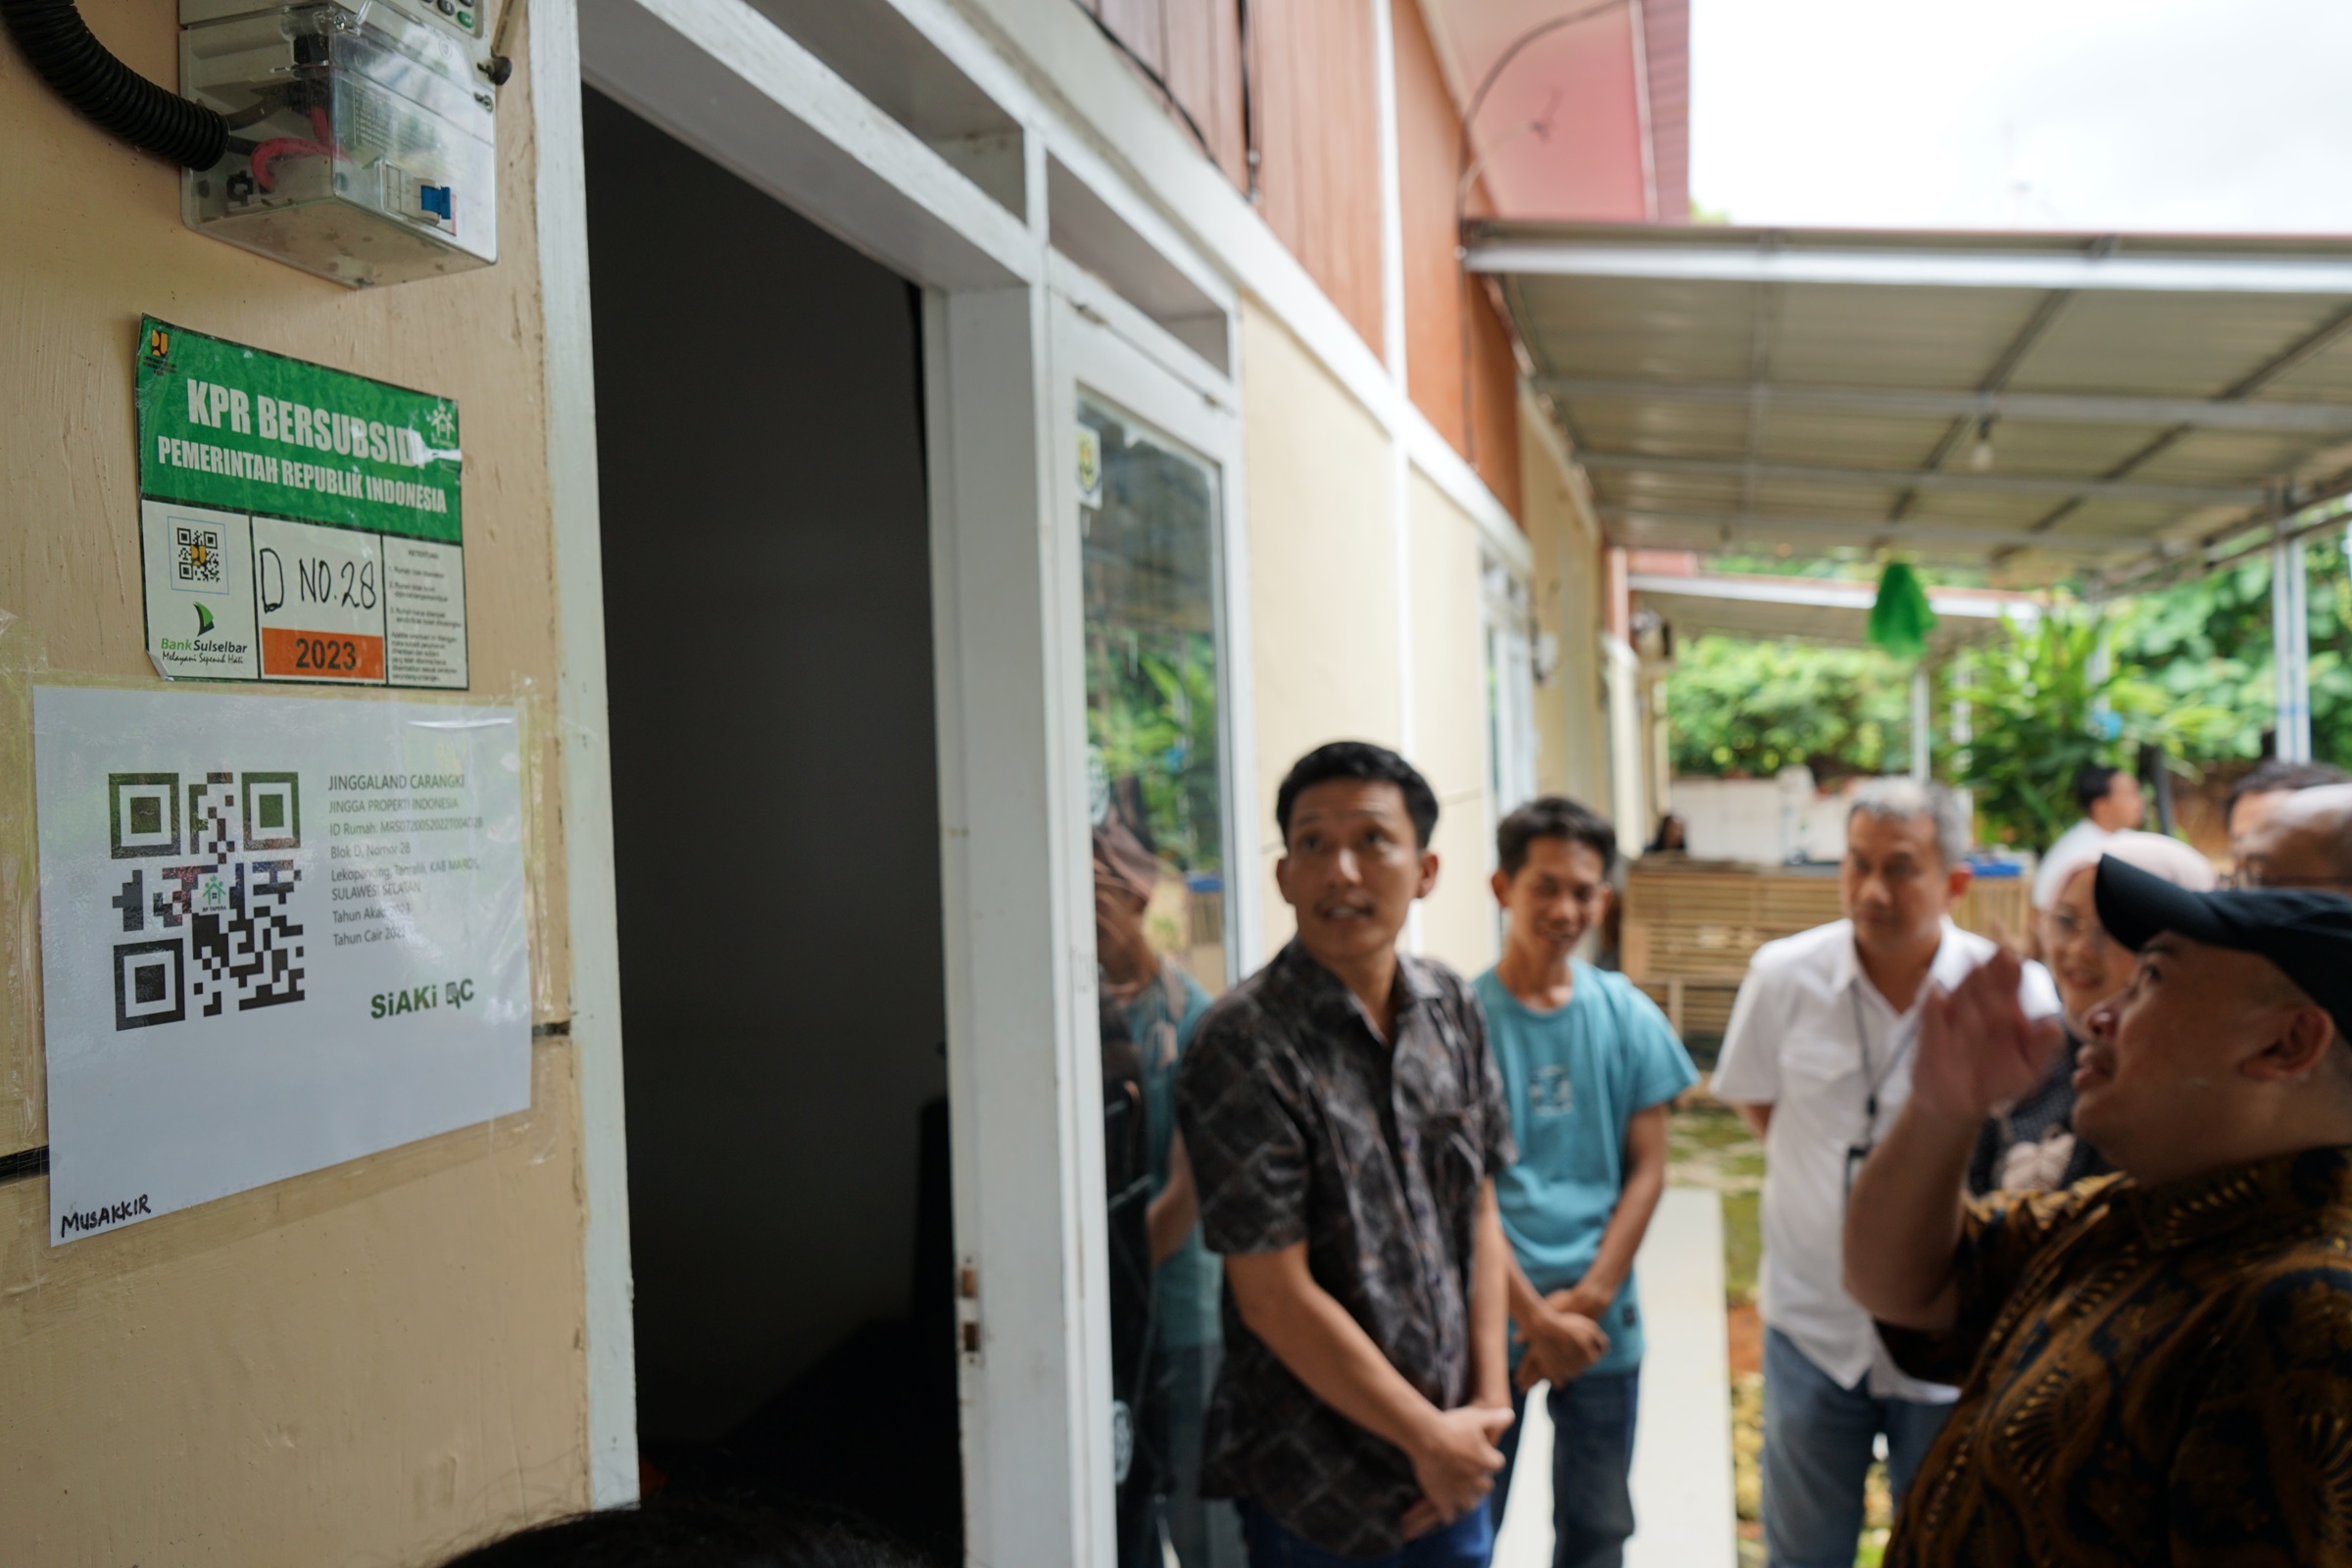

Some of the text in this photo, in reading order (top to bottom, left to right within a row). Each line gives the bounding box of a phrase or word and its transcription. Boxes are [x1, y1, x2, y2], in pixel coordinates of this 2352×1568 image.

[187, 377, 251, 435] KPR
[158, 435, 447, 514] PEMERINTAH REPUBLIK INDONESIA
[260, 548, 284, 613] D
[162, 651, 244, 665] Melayani Sepenuh Hati
[295, 638, 357, 670] 2023
[328, 773, 466, 791] JINGGALAND CARANGKI
[328, 798, 460, 813] JINGGA PROPERTI INDONESIA
[329, 822, 341, 836] ID
[330, 846, 352, 859] Blok
[366, 843, 398, 858] Nomor
[399, 842, 411, 856] 28
[331, 908, 362, 923] Tahun
[333, 926, 406, 947] Tahun Cair 20
[370, 984, 437, 1019] SiAKi
[61, 1194, 151, 1238] MUSAKKIR
